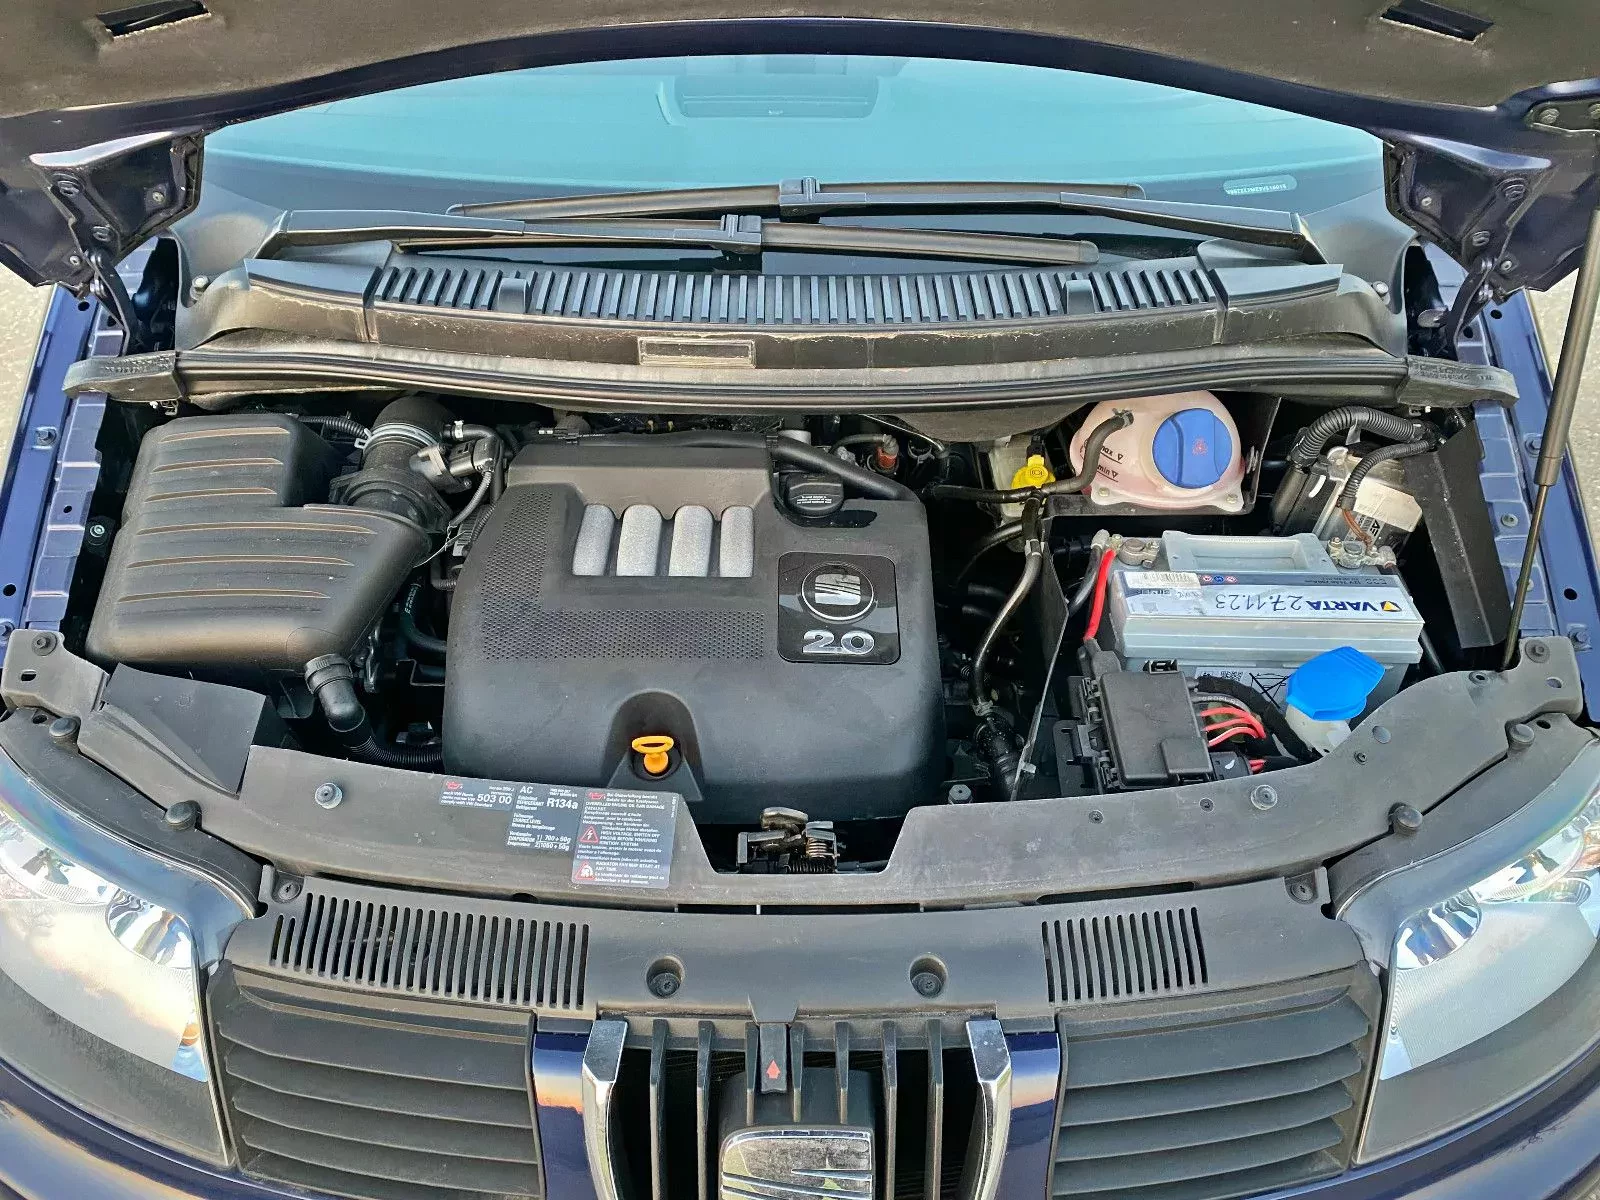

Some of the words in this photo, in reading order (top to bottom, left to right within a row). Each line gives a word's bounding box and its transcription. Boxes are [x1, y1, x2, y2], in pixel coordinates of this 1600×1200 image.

[1097, 465, 1110, 476] min
[1215, 594, 1303, 611] 27.11.23
[1306, 600, 1379, 611] VARTA
[802, 629, 875, 654] 2.0
[520, 786, 533, 794] AC
[477, 793, 497, 803] 503
[499, 795, 512, 804] 00
[547, 797, 579, 809] R134a
